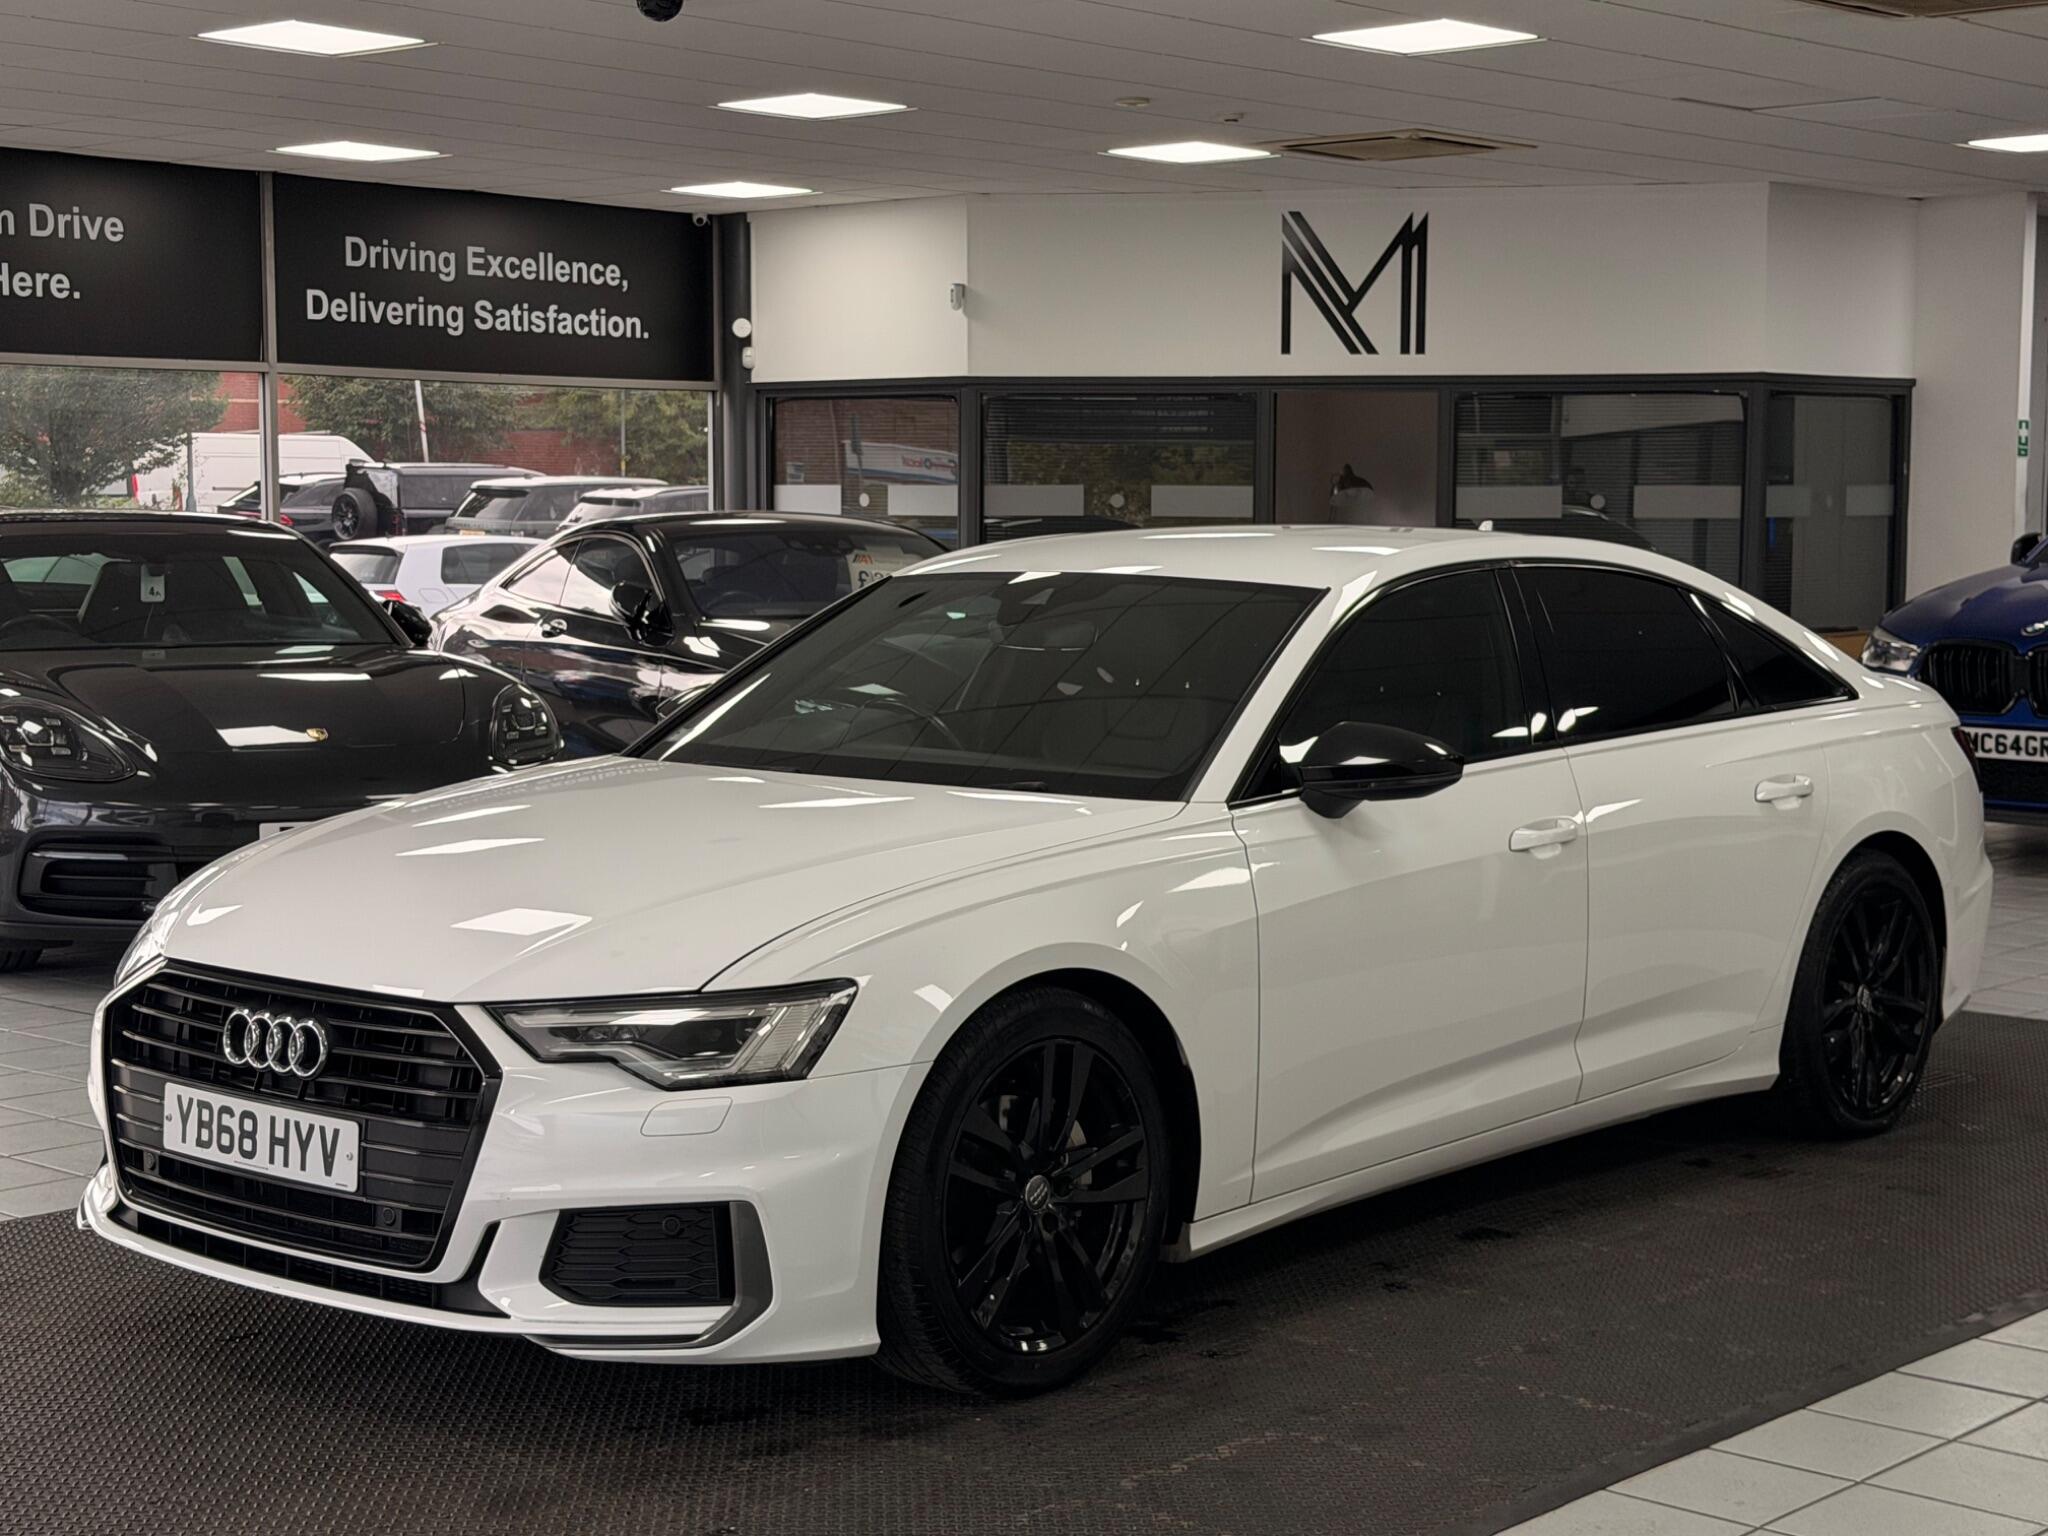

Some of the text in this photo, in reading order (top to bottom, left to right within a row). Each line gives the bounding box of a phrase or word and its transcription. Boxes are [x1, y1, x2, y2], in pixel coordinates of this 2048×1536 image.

[29, 203, 125, 242] Drive
[344, 235, 628, 292] Driving Excellence,
[306, 288, 649, 339] Delivering Satisfaction.
[177, 1094, 341, 1177] YB68 HYV
